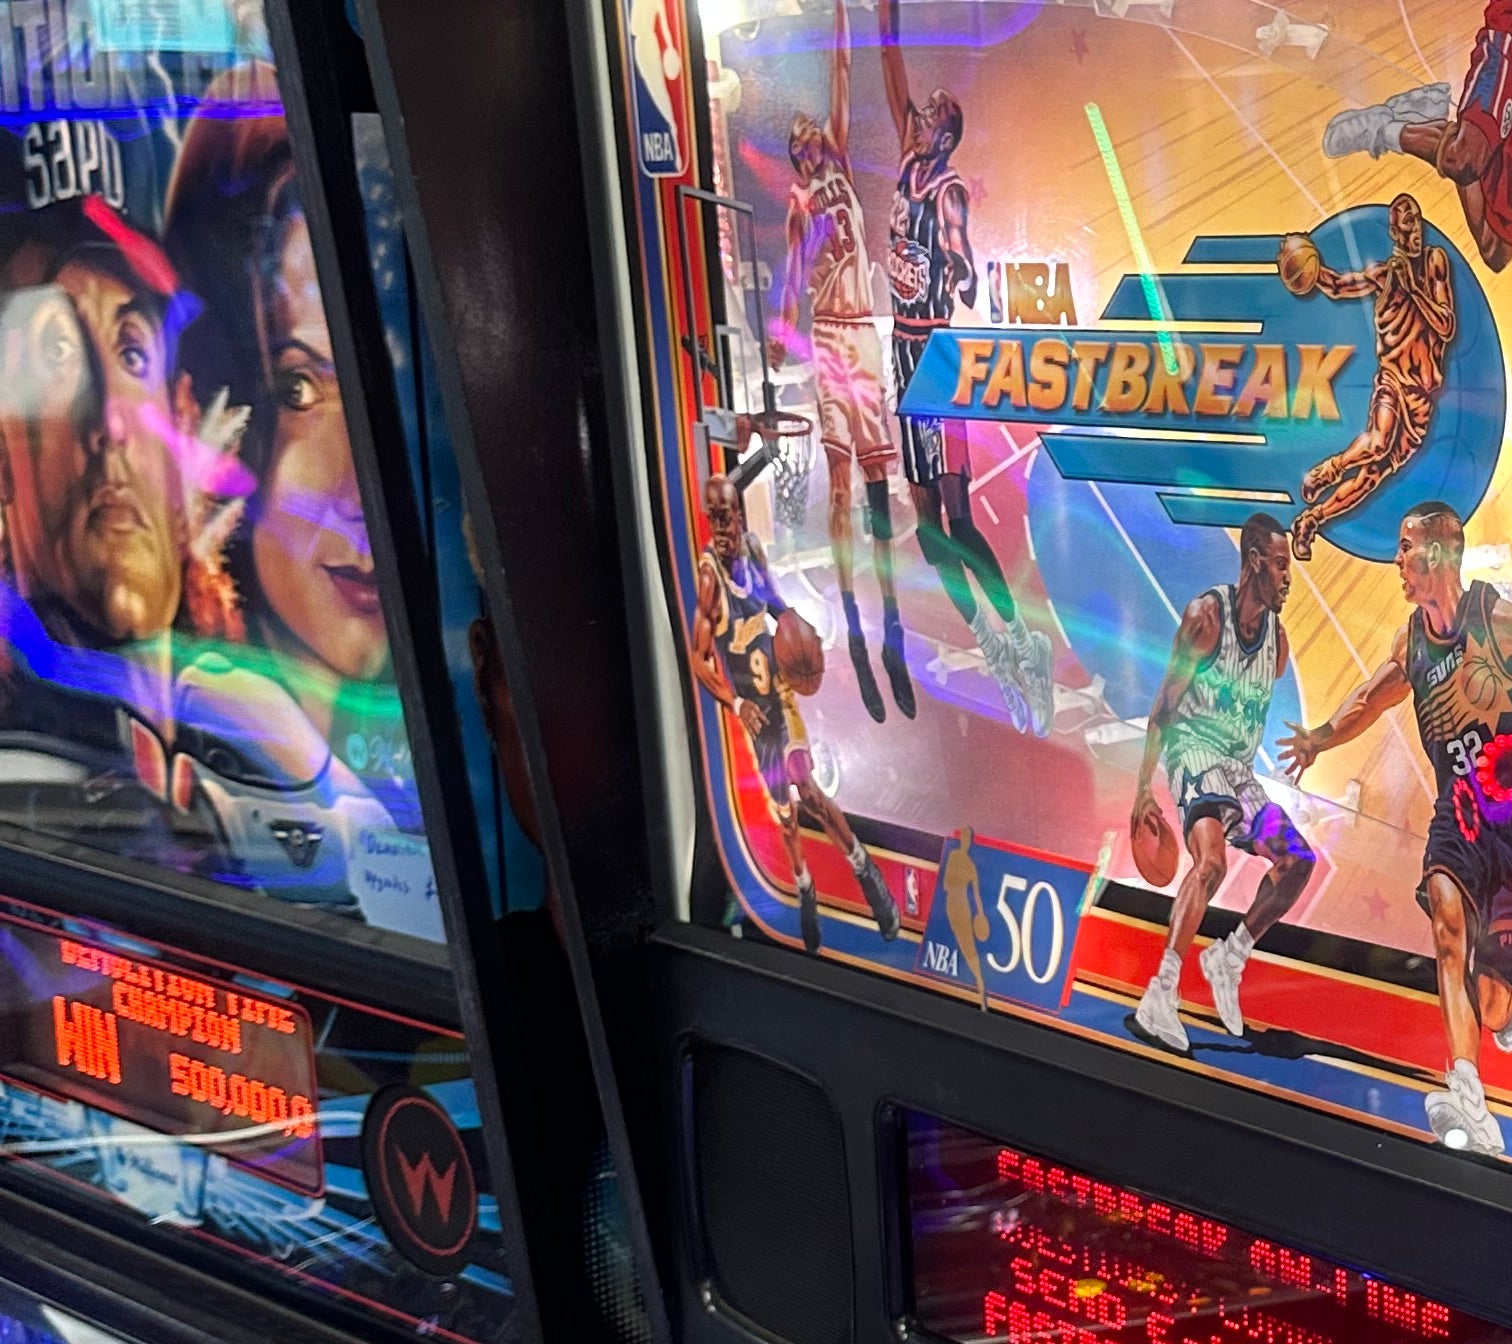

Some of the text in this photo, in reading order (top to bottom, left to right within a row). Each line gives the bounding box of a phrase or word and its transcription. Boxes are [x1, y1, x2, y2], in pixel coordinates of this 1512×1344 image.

[643, 131, 674, 162] NBA
[1006, 262, 1078, 325] NBA
[950, 337, 1357, 422] FASTBREAK
[1426, 644, 1463, 688] SUNS
[1446, 730, 1483, 776] 32
[923, 873, 1064, 984] NBA 50
[53, 995, 122, 1085] WIN
[1010, 1256, 1127, 1332] SEND
